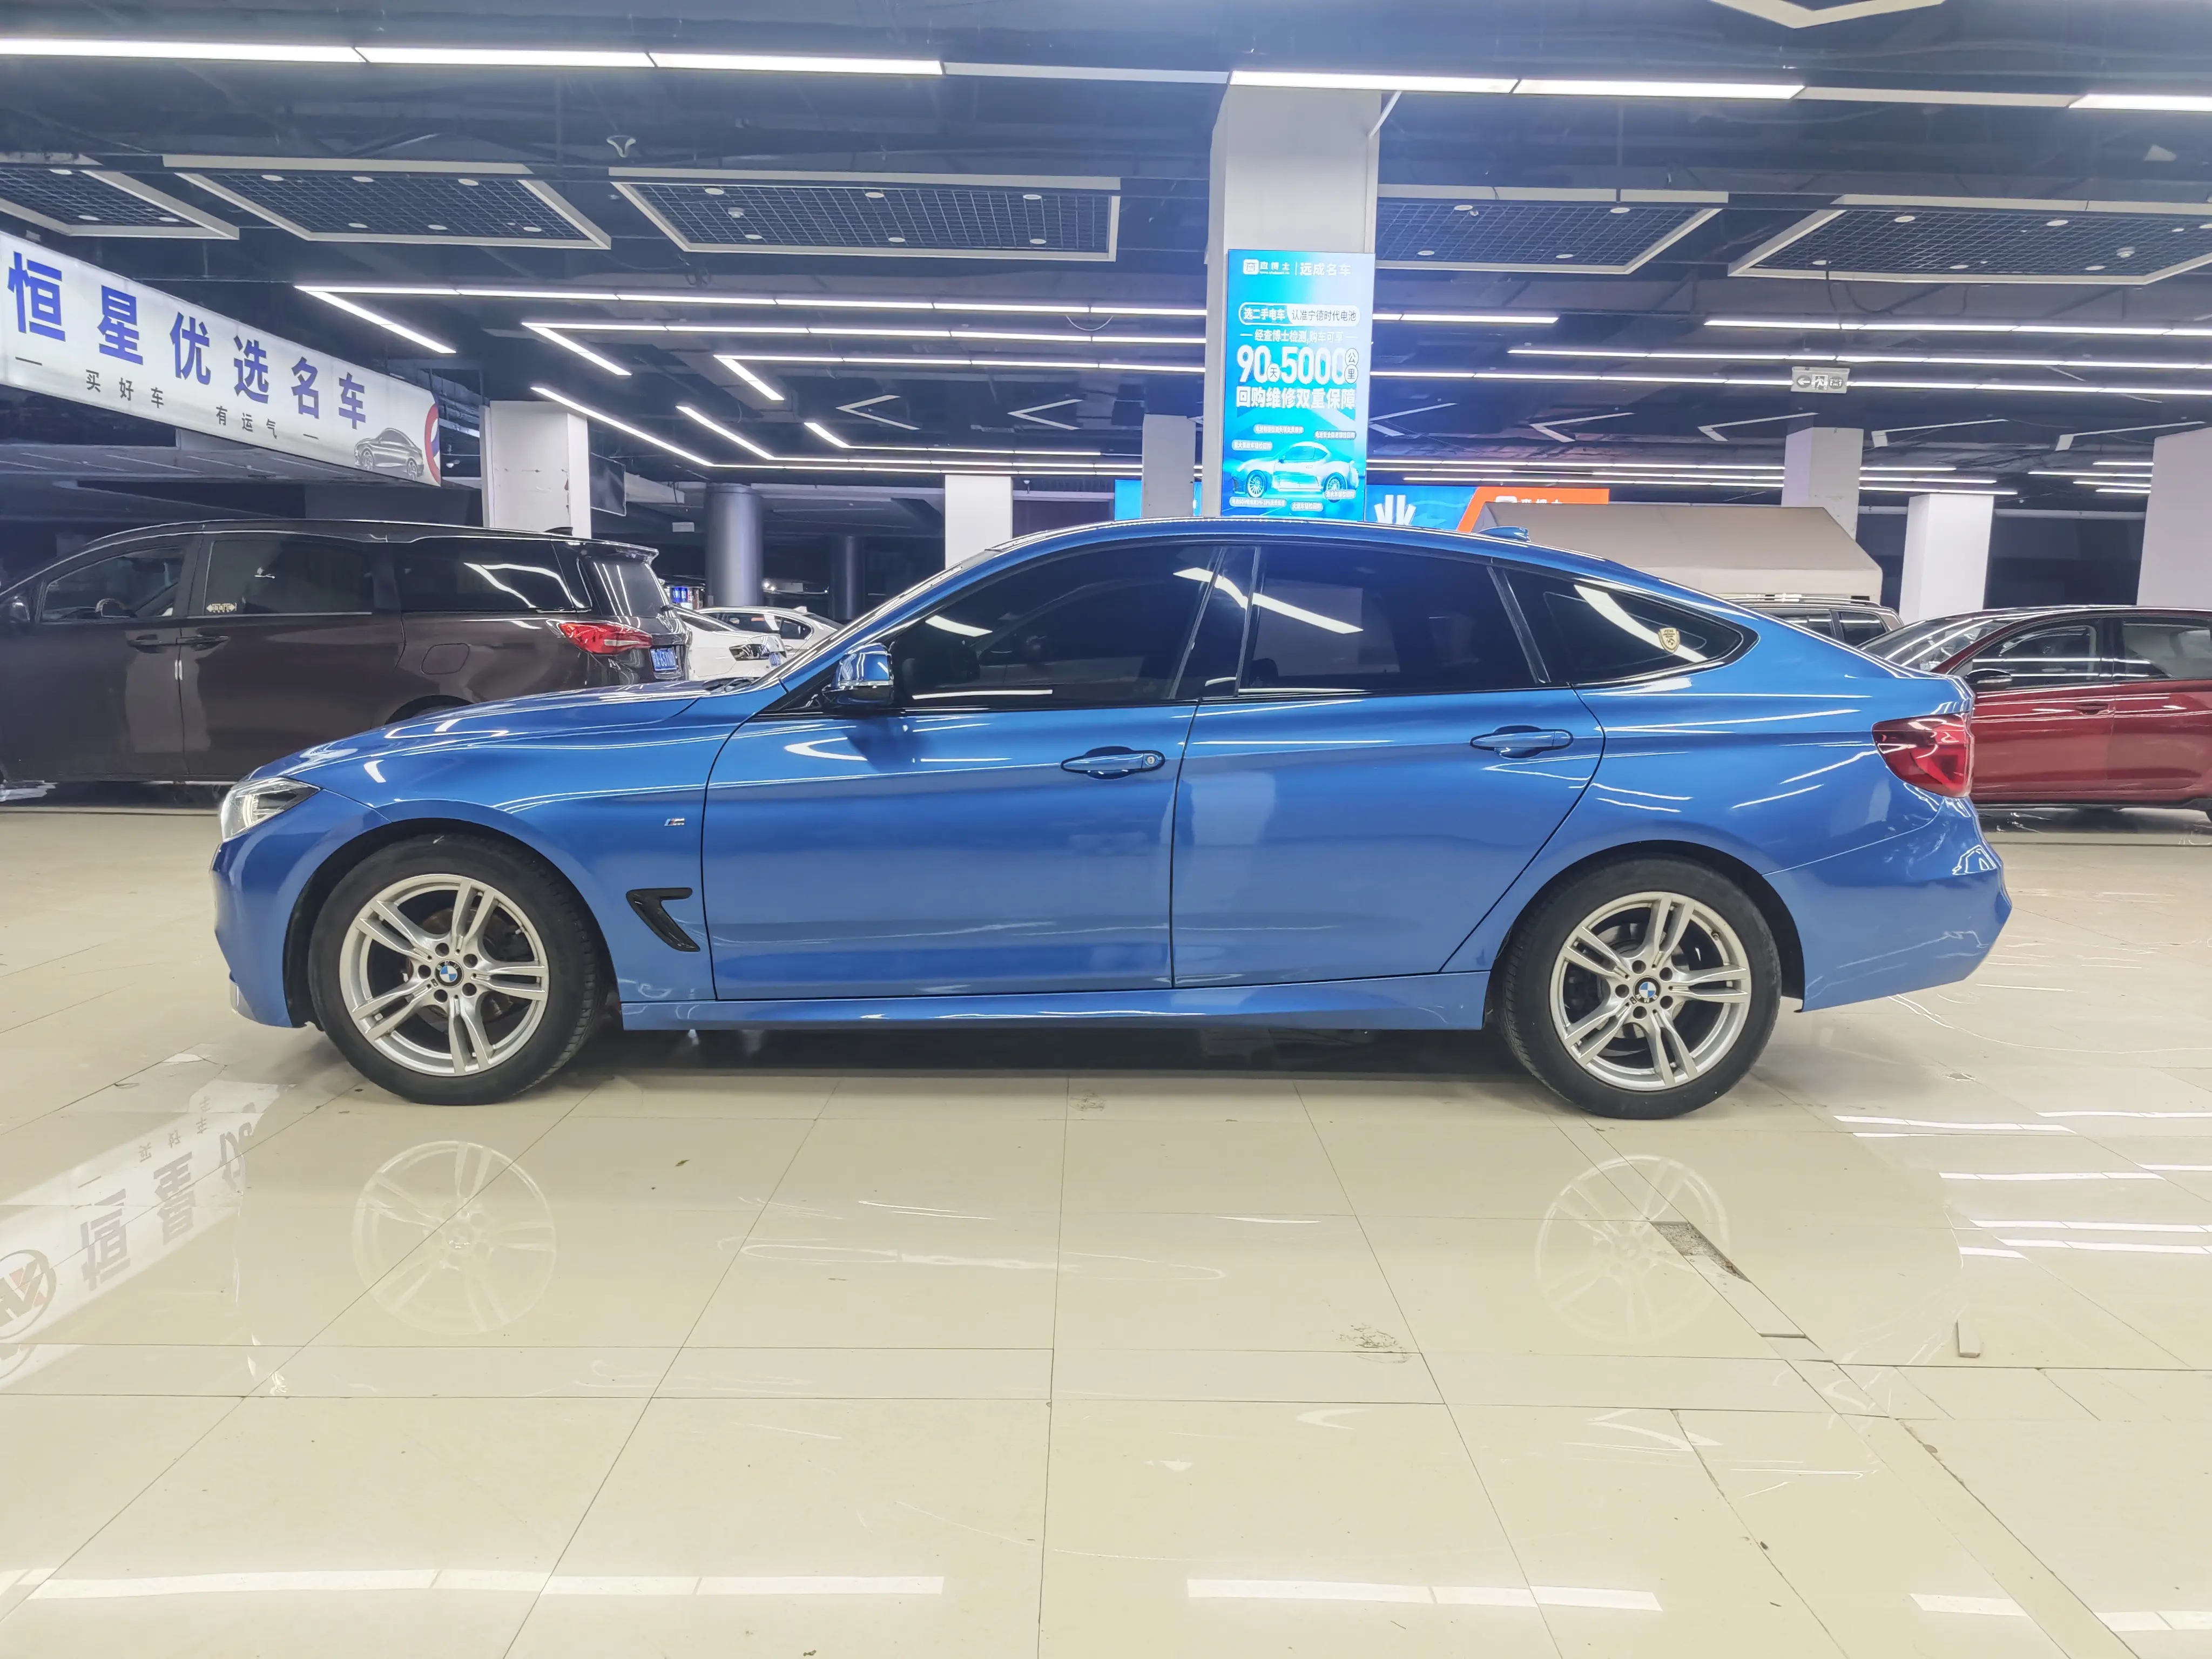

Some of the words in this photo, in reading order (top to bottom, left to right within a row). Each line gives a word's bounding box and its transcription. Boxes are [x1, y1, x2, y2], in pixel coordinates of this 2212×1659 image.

[1292, 309, 1356, 321] 认准宁德时代电池
[8, 251, 367, 429] 恒星优选名车
[85, 369, 165, 409] 买好车
[215, 406, 278, 440] 有运气
[1236, 387, 1356, 409] 回购维修双重保障
